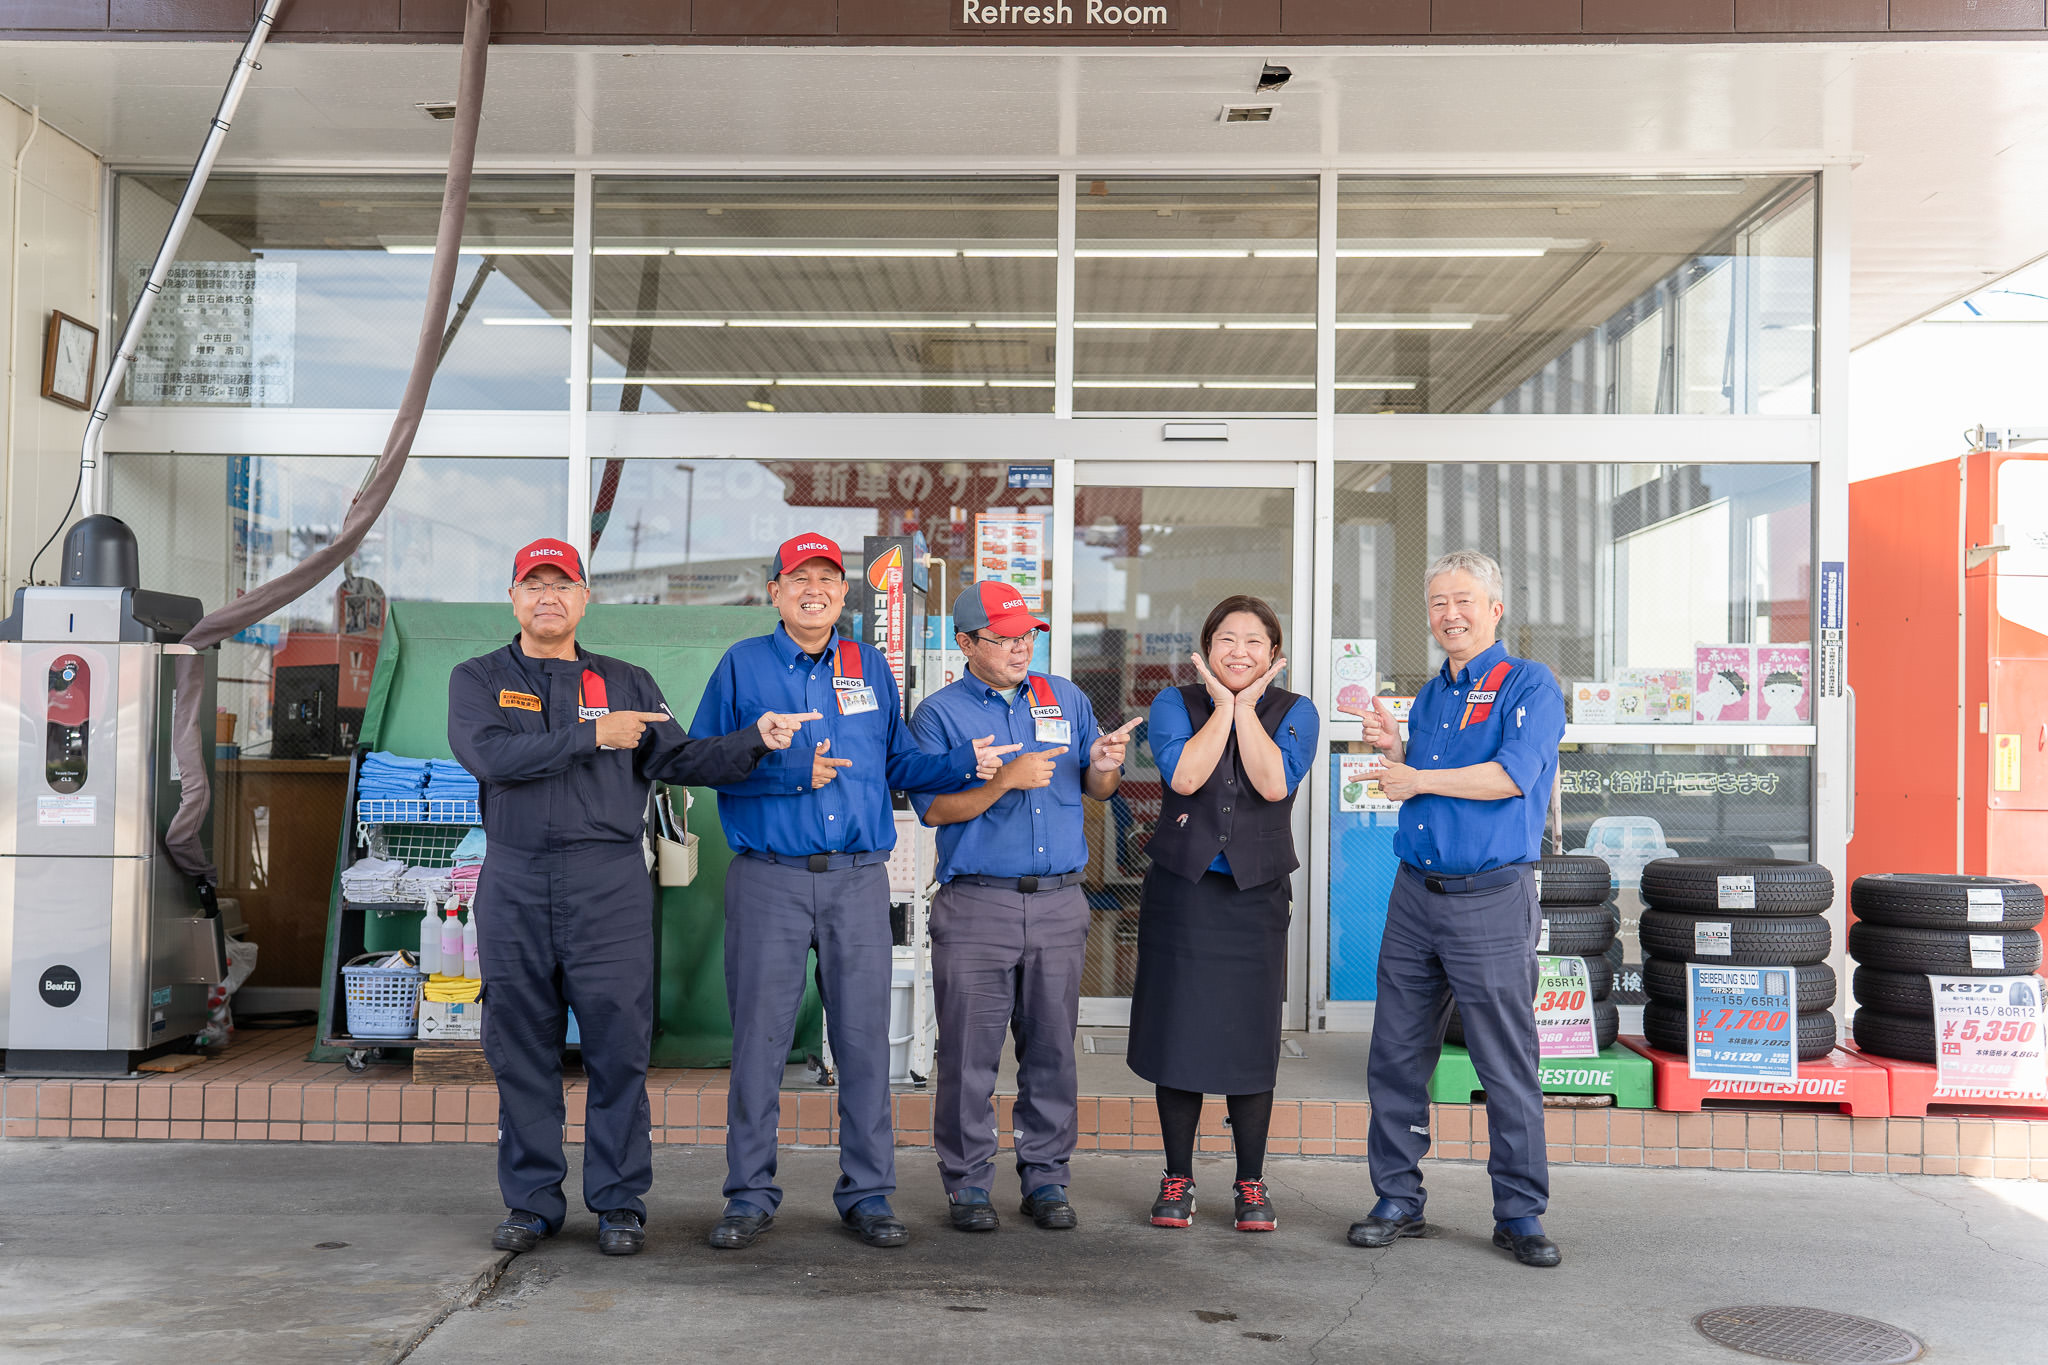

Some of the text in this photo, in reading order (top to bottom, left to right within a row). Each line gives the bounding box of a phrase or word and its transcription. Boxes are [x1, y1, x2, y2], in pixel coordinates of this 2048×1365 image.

[962, 0, 1167, 25] Refresh Room
[530, 548, 564, 558] ENEOS
[797, 542, 829, 552] ENEOS
[1708, 649, 1741, 662] 赤ちゃん
[1769, 650, 1801, 662] 赤ちゃん
[835, 679, 862, 687] ENEOS
[580, 709, 606, 717] ENEOS
[1033, 708, 1059, 716] ENEOS
[1560, 770, 1779, 795] 点検・給油中にできます
[1540, 977, 1584, 988] /65R14
[1700, 972, 1759, 986] SEIBERLING SL101
[45, 980, 75, 992] Beauty
[1940, 983, 2004, 994] K370
[1535, 990, 1586, 1013] ,340
[1967, 1006, 2035, 1018] 145/80R12
[1943, 1020, 2036, 1043] ¥5,350
